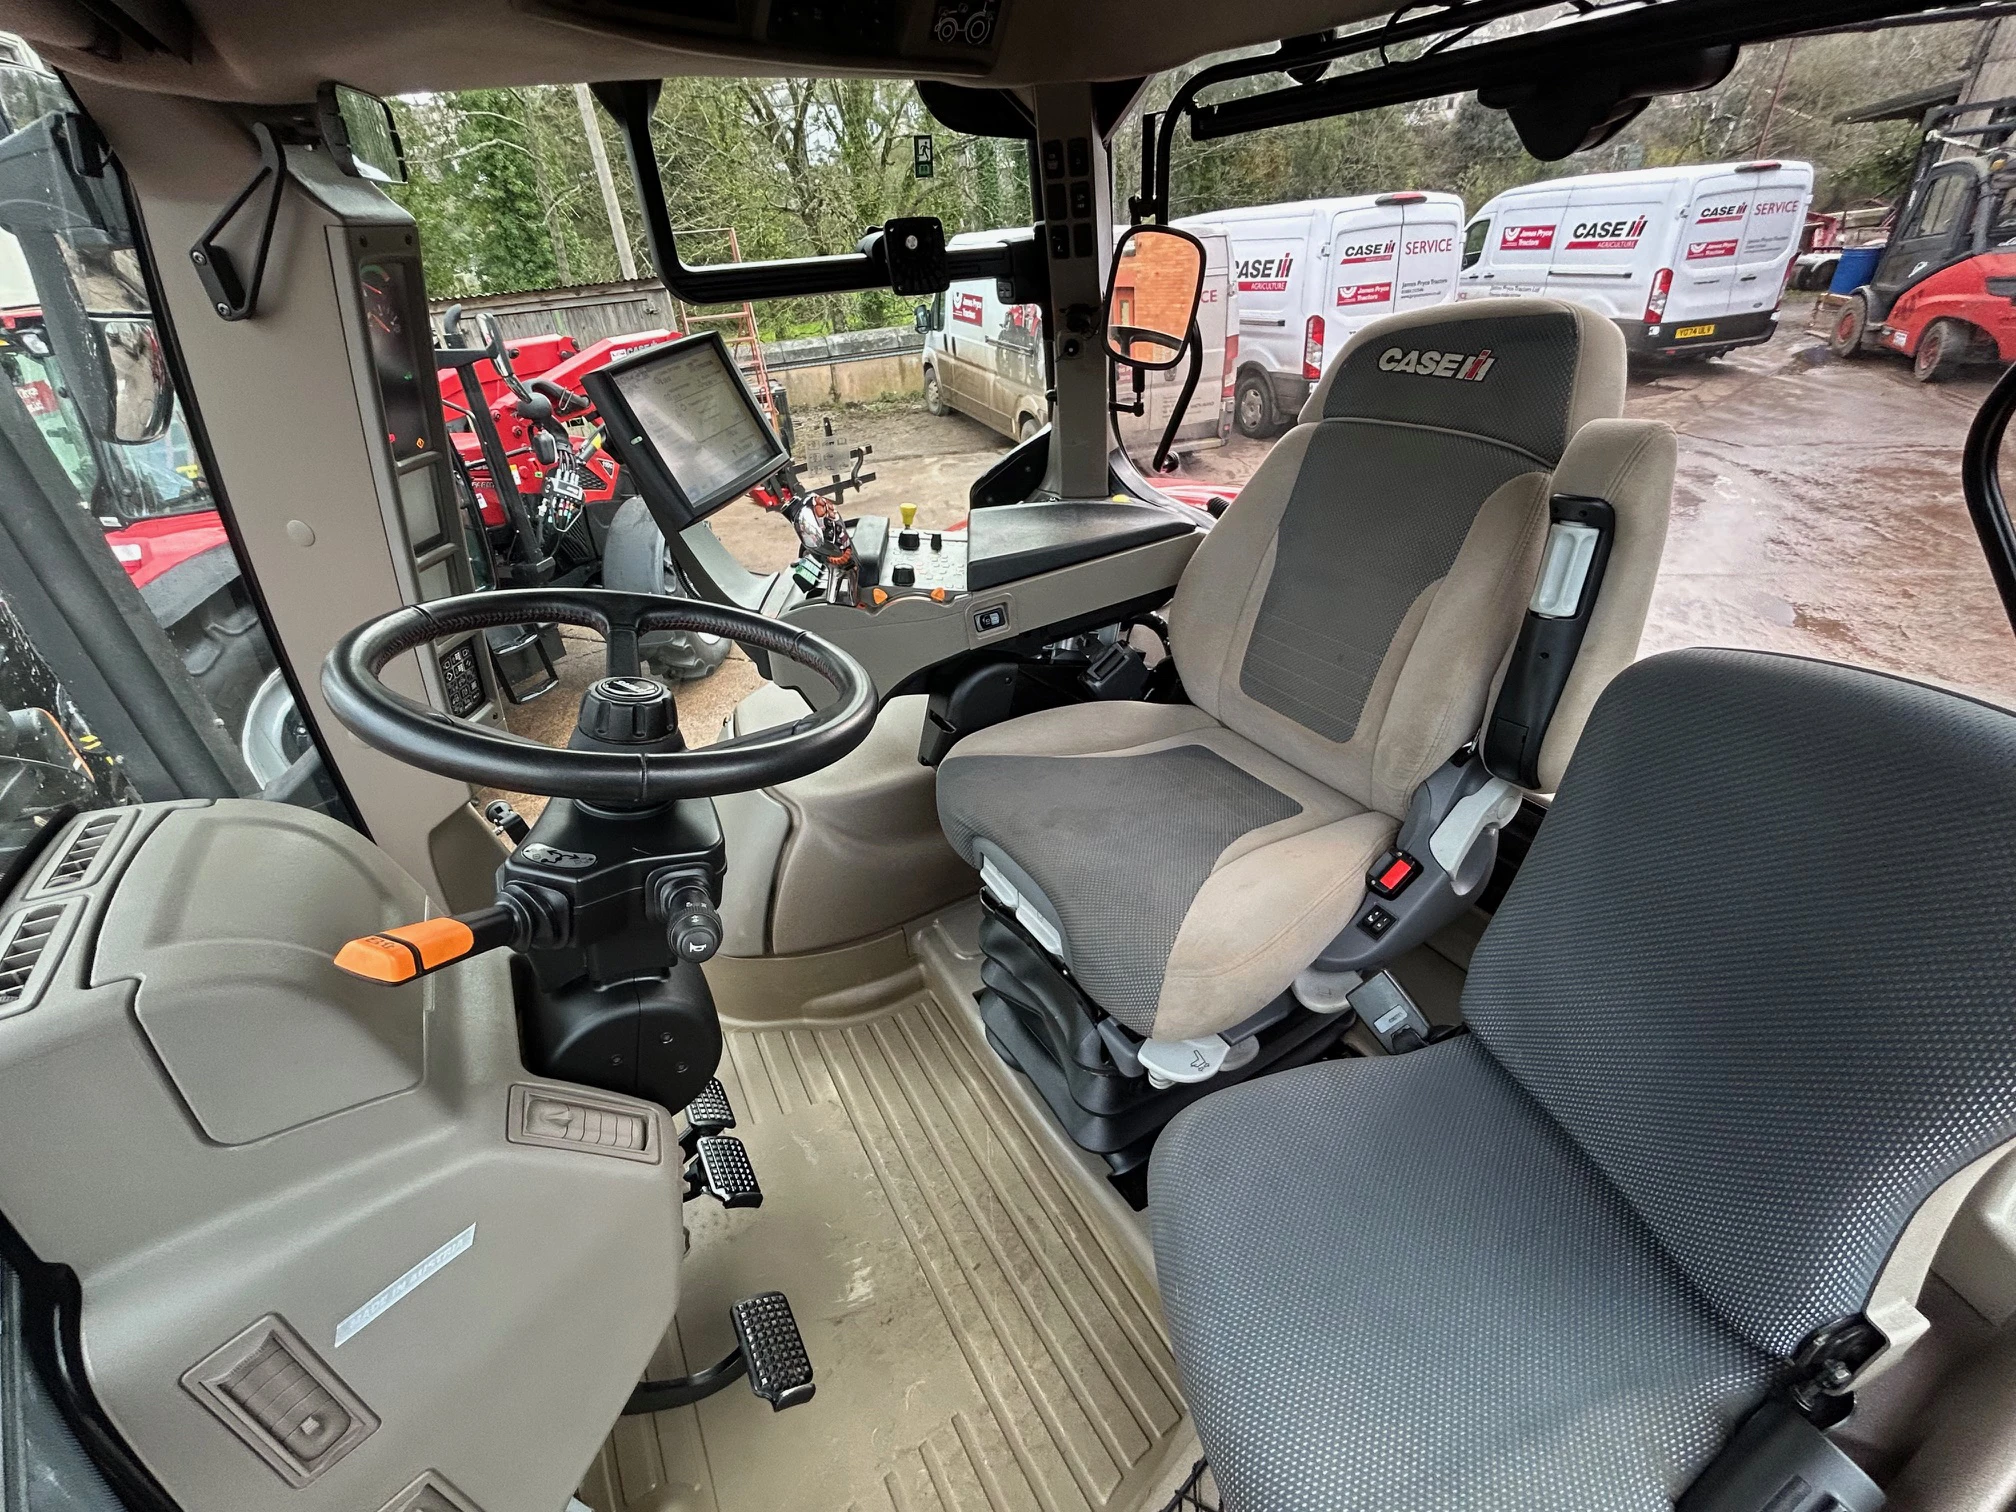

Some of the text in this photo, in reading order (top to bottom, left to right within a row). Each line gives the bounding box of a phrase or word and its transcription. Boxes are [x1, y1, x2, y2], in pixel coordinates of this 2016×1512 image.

[1701, 205, 1736, 218] CASE
[1754, 200, 1799, 216] SERVICE
[1573, 221, 1627, 239] CASE
[1345, 243, 1383, 257] CASE
[1405, 238, 1453, 255] SERVICE
[1597, 240, 1635, 248] AGRICULTURE
[1251, 282, 1285, 290] AGRICULTURE
[1379, 347, 1464, 377] CASE
[392, 1281, 407, 1298] IN
[409, 1239, 464, 1284] AUSTRIA
